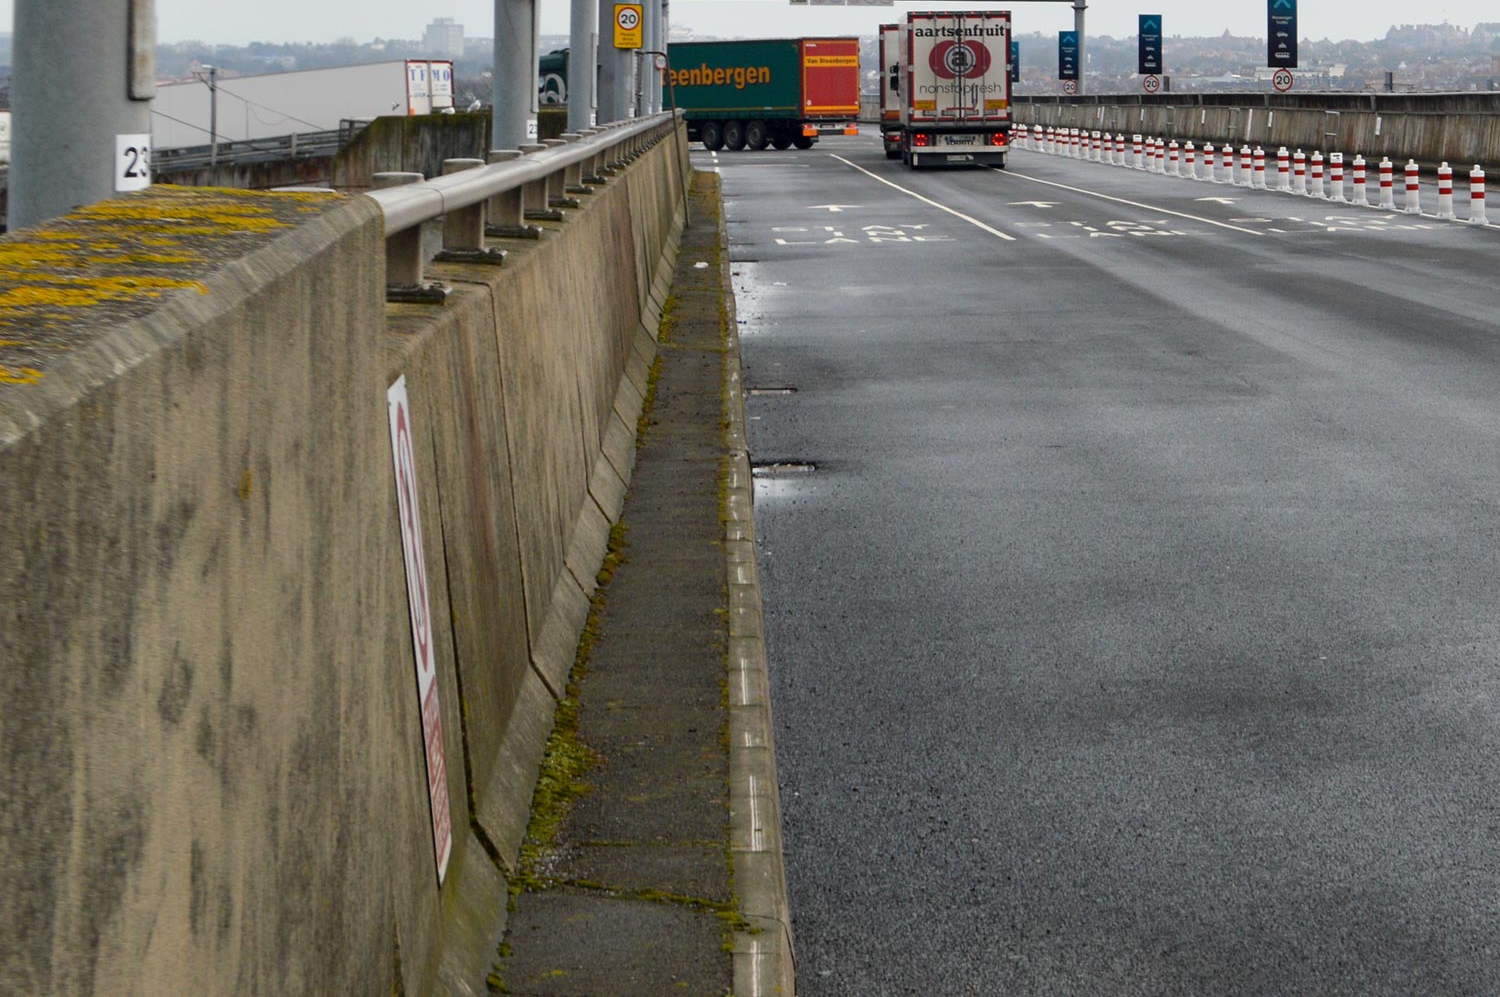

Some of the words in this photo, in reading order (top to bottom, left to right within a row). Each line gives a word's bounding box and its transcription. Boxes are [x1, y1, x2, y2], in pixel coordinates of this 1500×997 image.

[621, 13, 637, 24] 20
[915, 24, 1005, 38] aartsenfruit
[1146, 80, 1157, 88] 20
[1276, 76, 1290, 85] 20
[919, 82, 1002, 96] nonstopfresh
